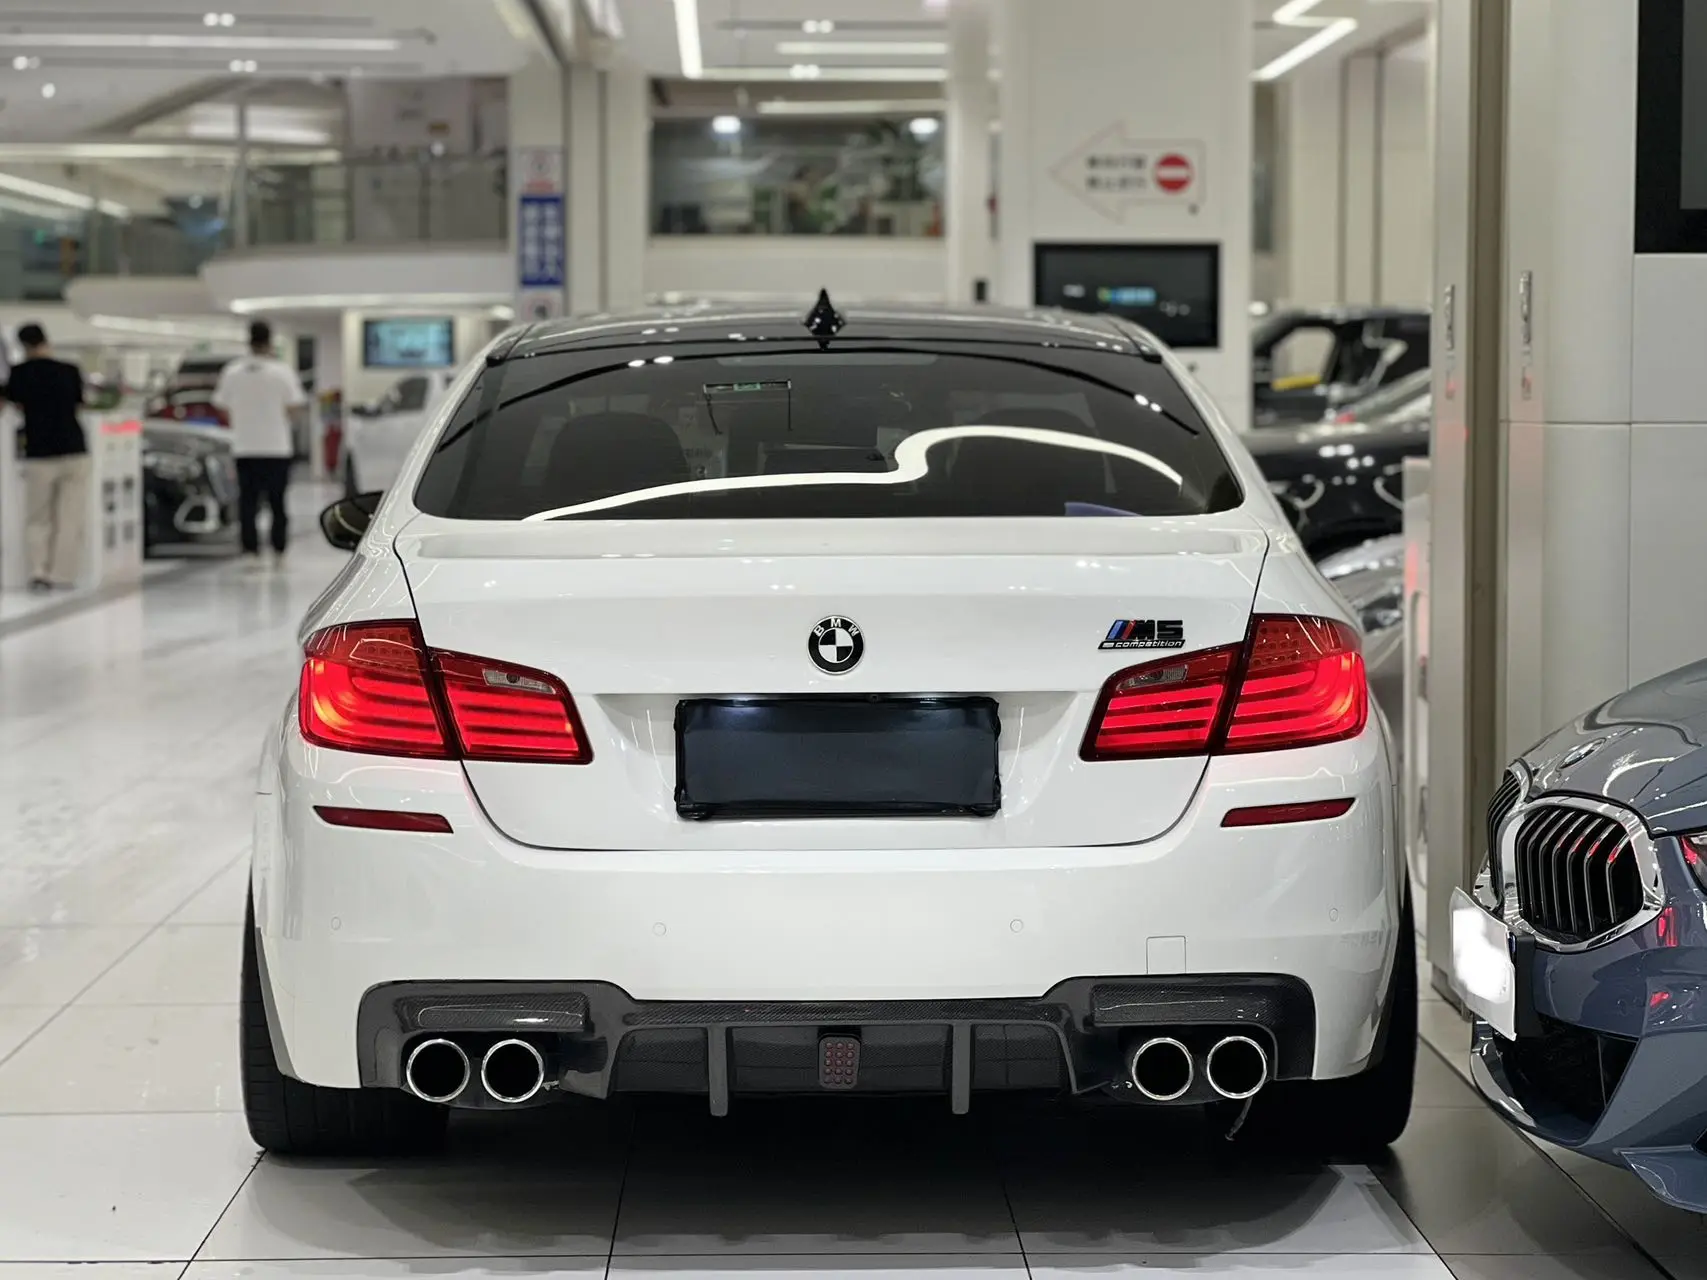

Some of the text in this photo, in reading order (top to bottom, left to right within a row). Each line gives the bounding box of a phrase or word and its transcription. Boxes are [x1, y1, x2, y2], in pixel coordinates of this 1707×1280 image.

[813, 618, 860, 637] BMW
[1124, 619, 1184, 640] M5
[1115, 640, 1183, 649] competition
